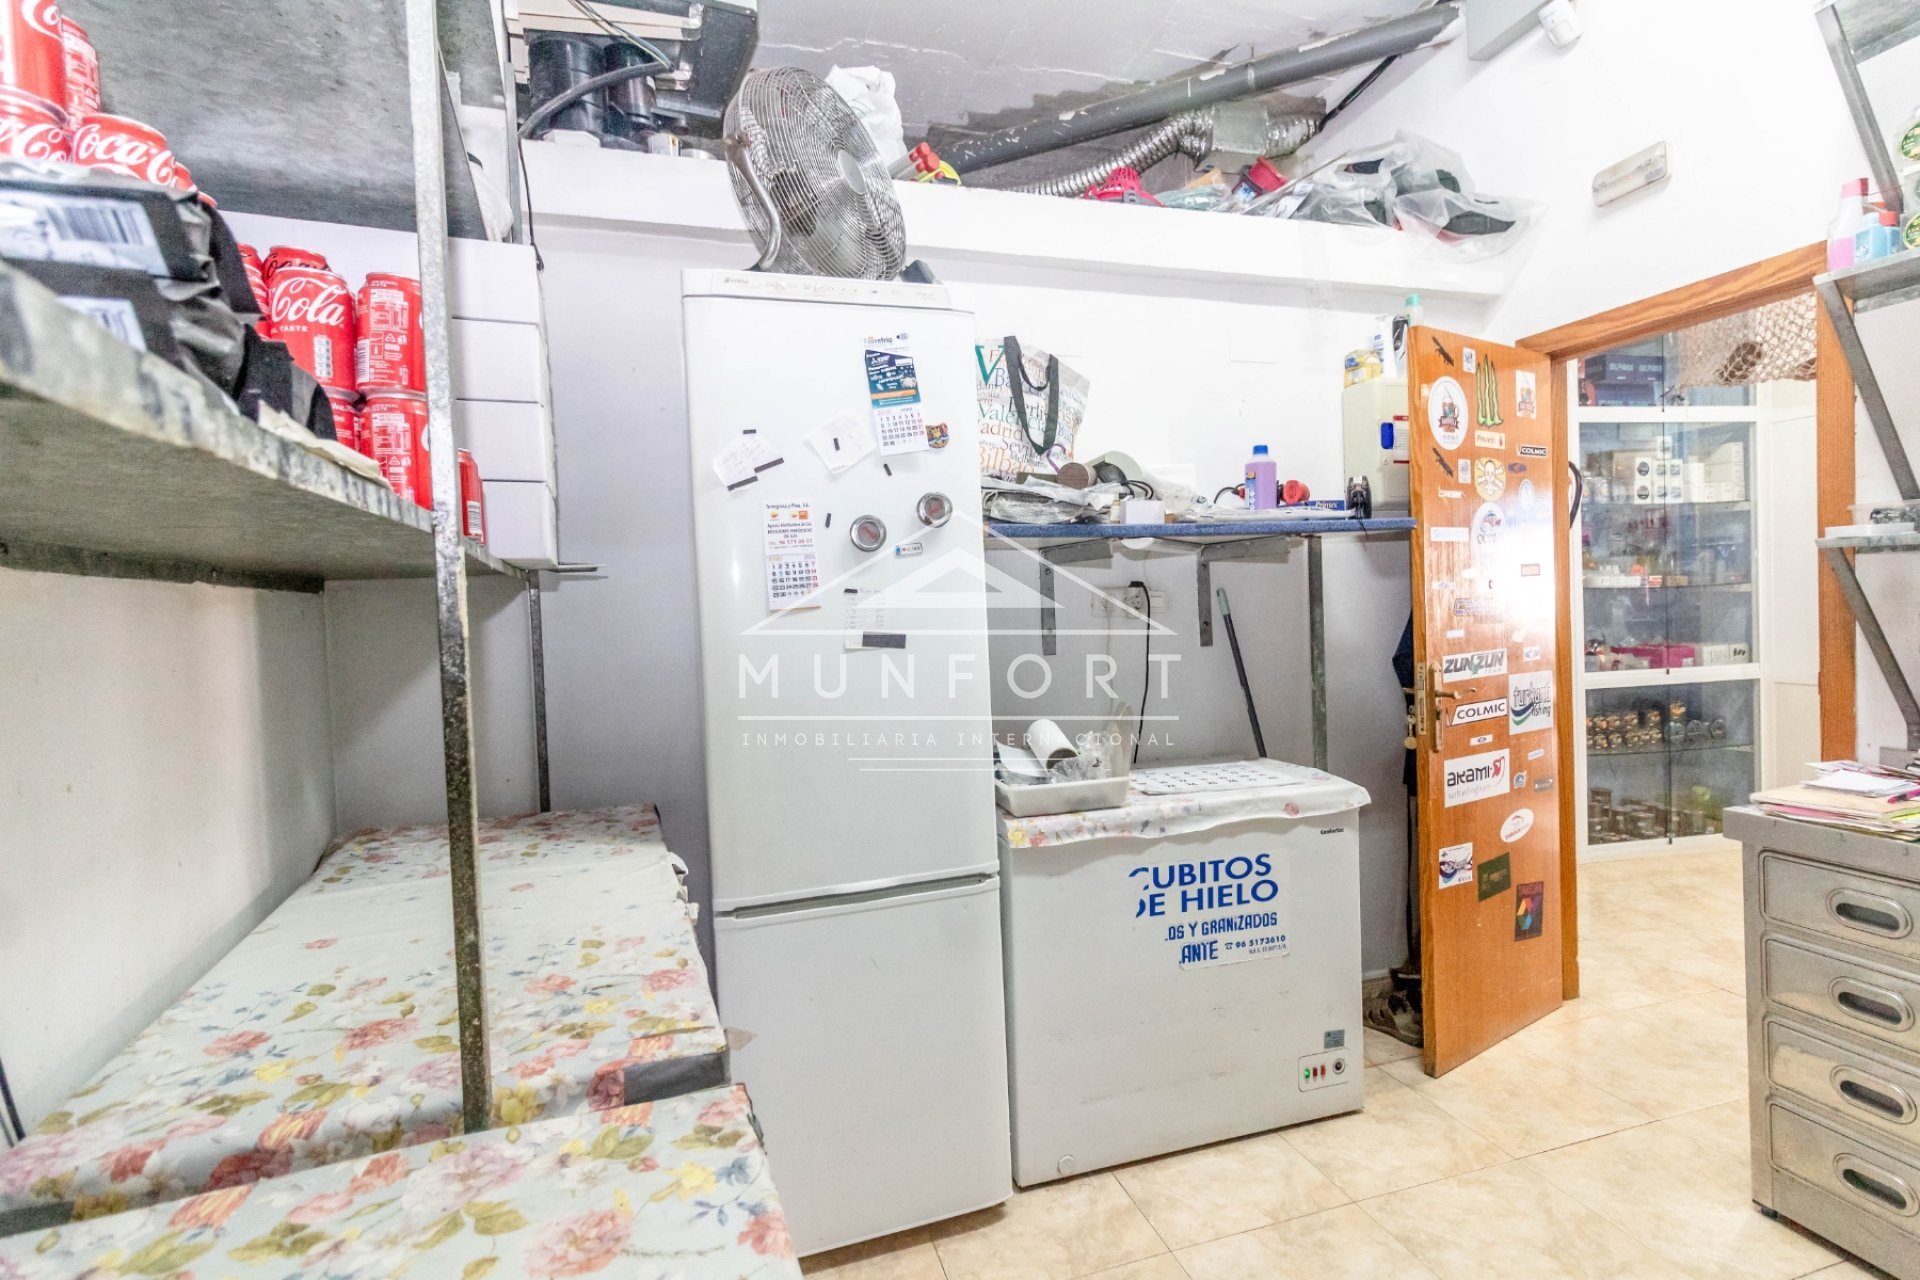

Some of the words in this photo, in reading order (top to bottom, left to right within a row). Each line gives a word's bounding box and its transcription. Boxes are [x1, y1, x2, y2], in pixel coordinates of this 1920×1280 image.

[271, 277, 346, 327] Cola
[280, 325, 309, 333] TASTE
[1521, 446, 1547, 456] COLMIC
[1457, 703, 1506, 720] COLMIC
[1181, 879, 1279, 913] HIELO
[1188, 921, 1198, 938] Y
[1179, 940, 1219, 965] ANTE
[1235, 941, 1247, 949] 96
[1249, 935, 1287, 947] 5173610
